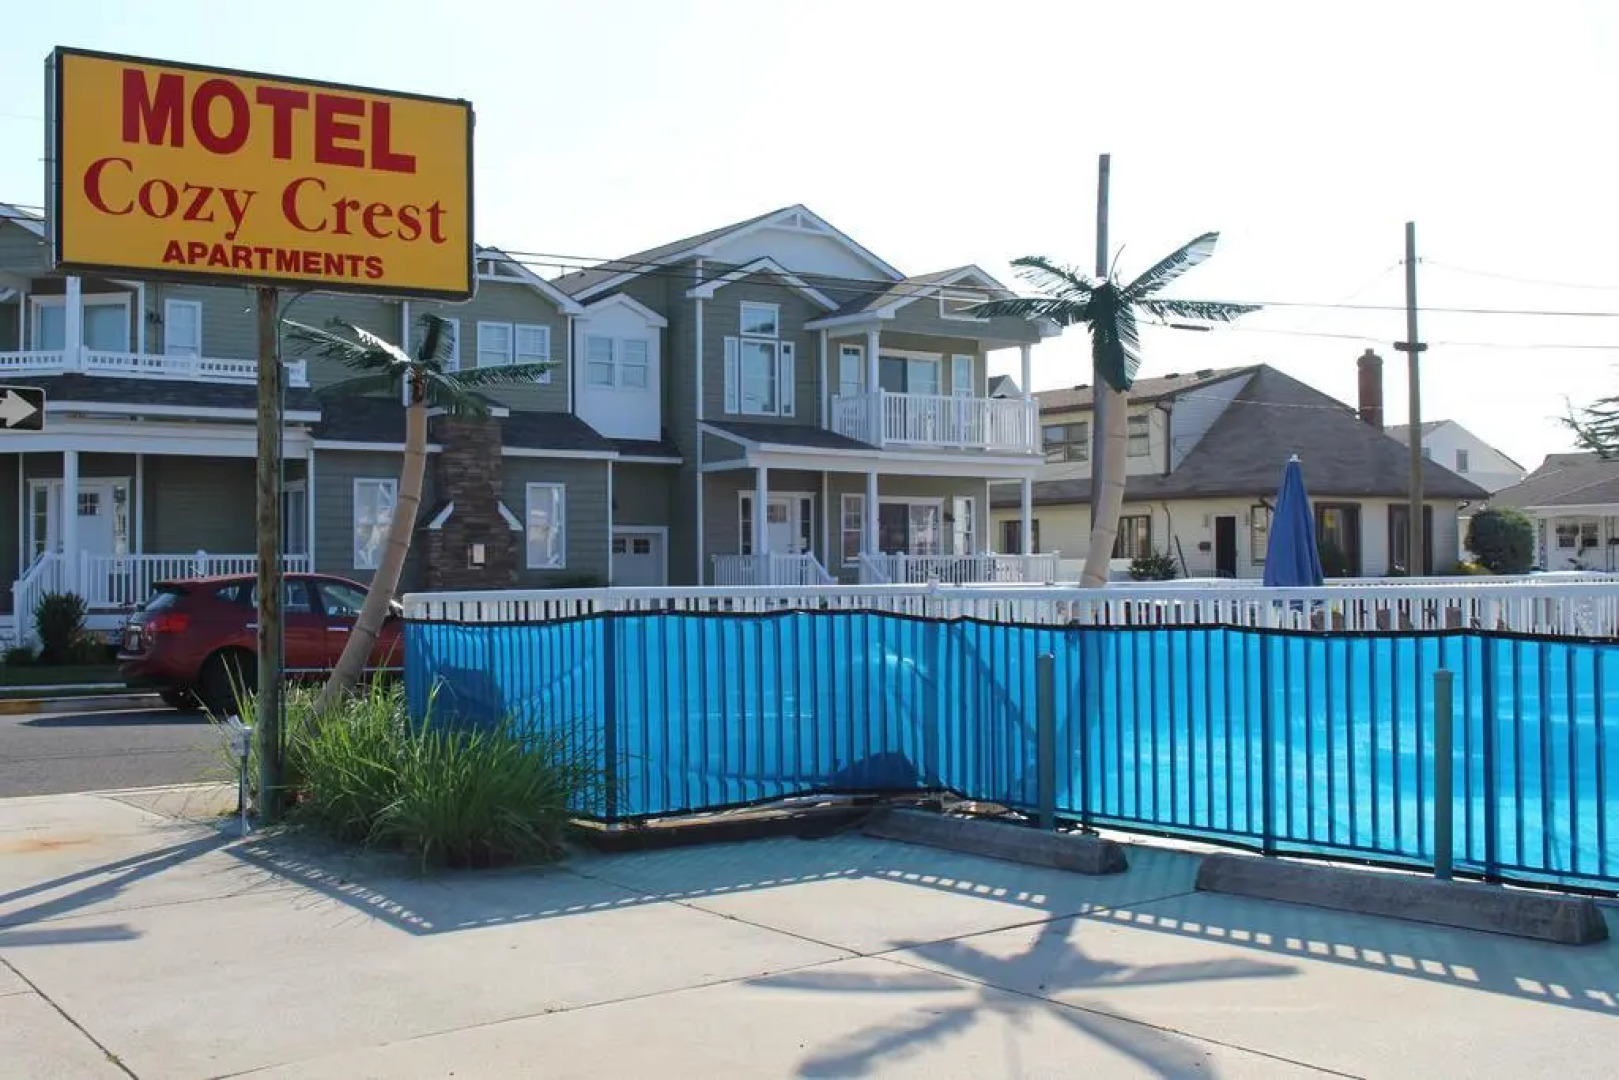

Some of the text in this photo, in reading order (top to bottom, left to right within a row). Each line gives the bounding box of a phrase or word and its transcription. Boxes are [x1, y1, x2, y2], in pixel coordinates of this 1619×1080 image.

[121, 68, 417, 175] MOTEL
[83, 157, 447, 244] Cozy Crest
[162, 240, 384, 279] APARTMENTS
